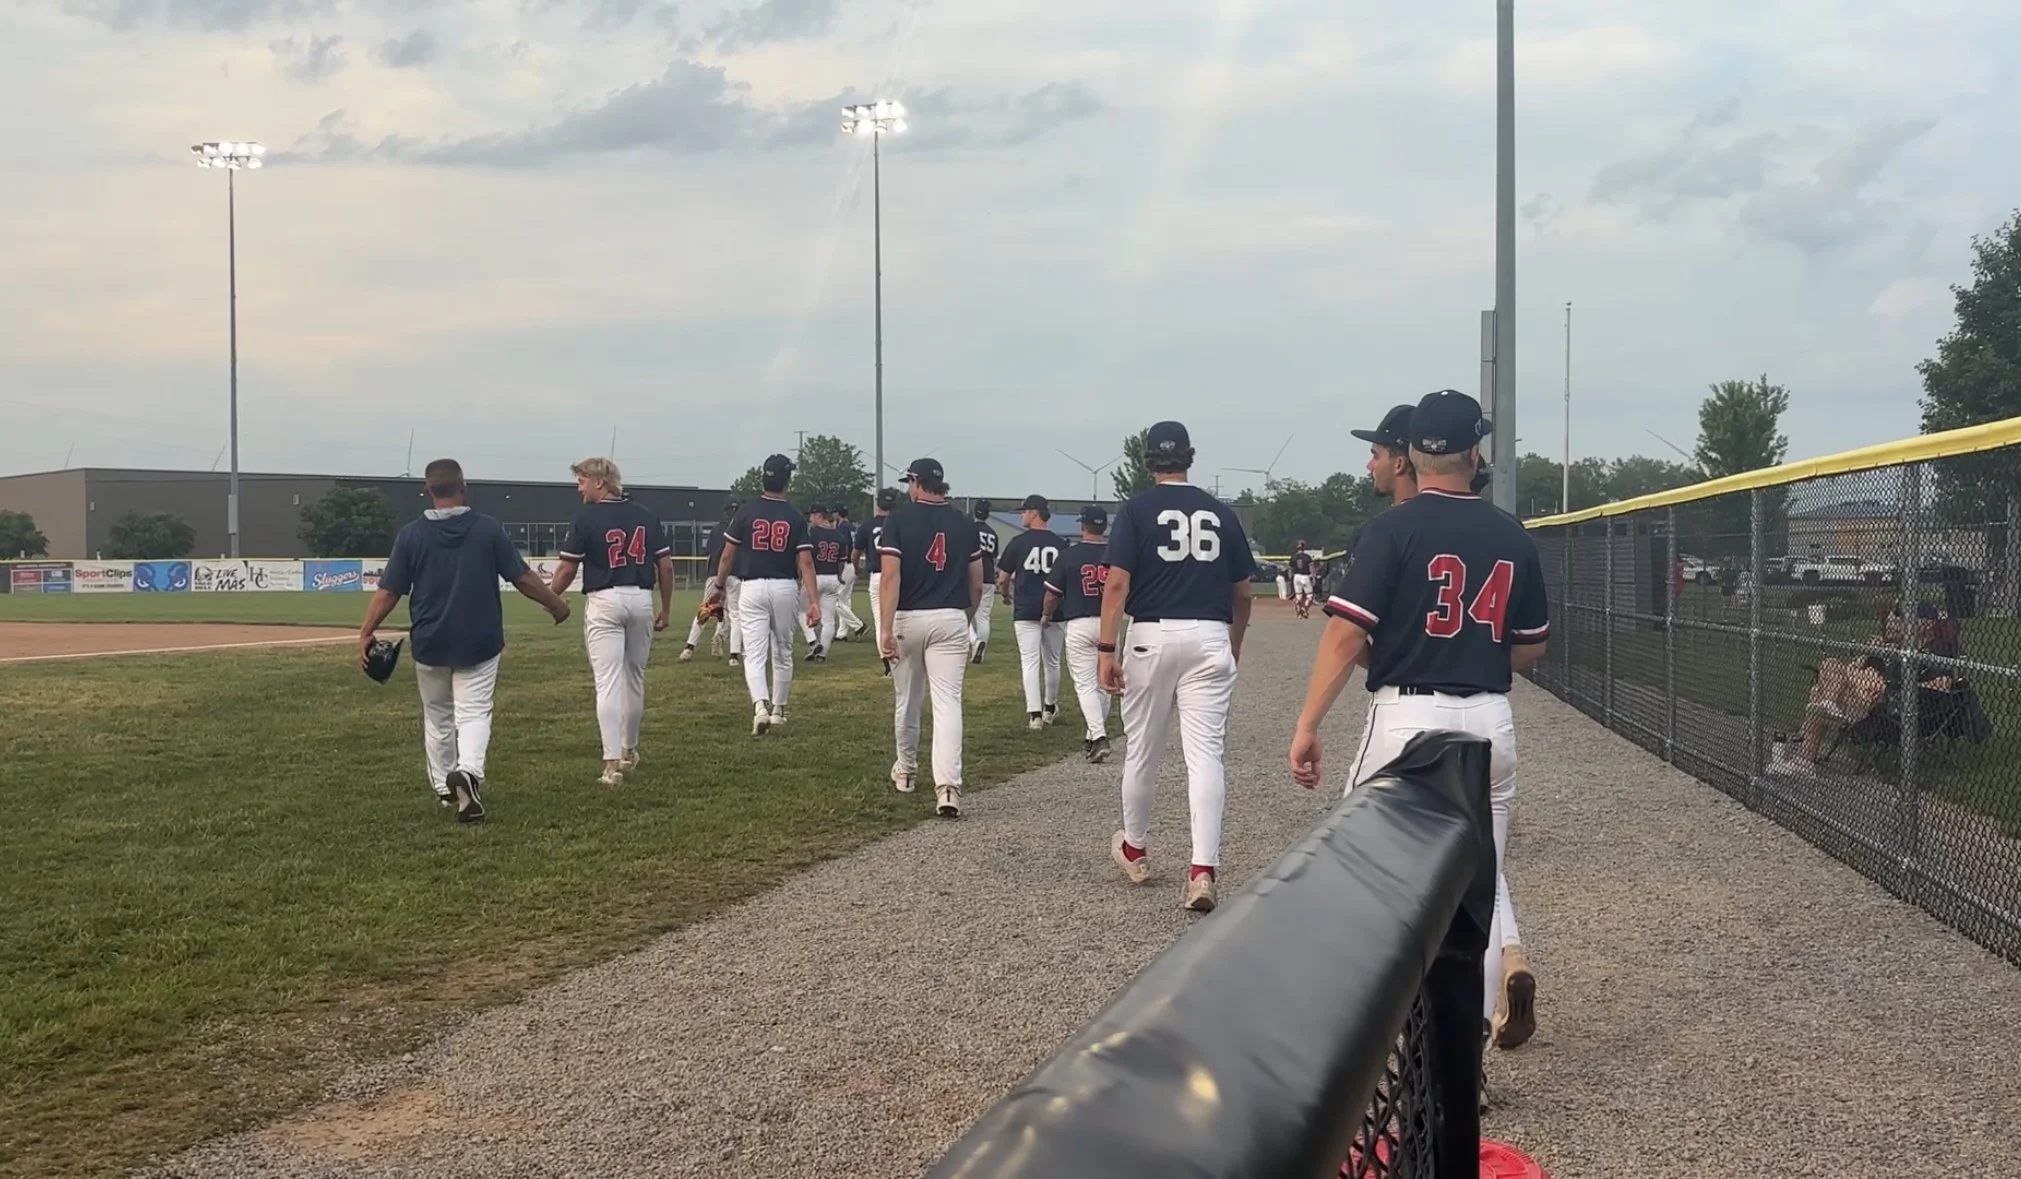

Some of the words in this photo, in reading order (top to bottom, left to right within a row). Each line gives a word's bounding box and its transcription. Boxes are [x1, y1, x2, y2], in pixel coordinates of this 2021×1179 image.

[605, 526, 646, 568] 24
[752, 519, 790, 552] 28
[979, 531, 996, 553] 55
[1157, 510, 1220, 562] 36
[817, 541, 840, 562] 32
[926, 532, 947, 571] 4
[1023, 546, 1059, 574] 40
[216, 569, 238, 580] LIVE
[312, 571, 360, 590] Sluggers
[1425, 554, 1514, 642] 34
